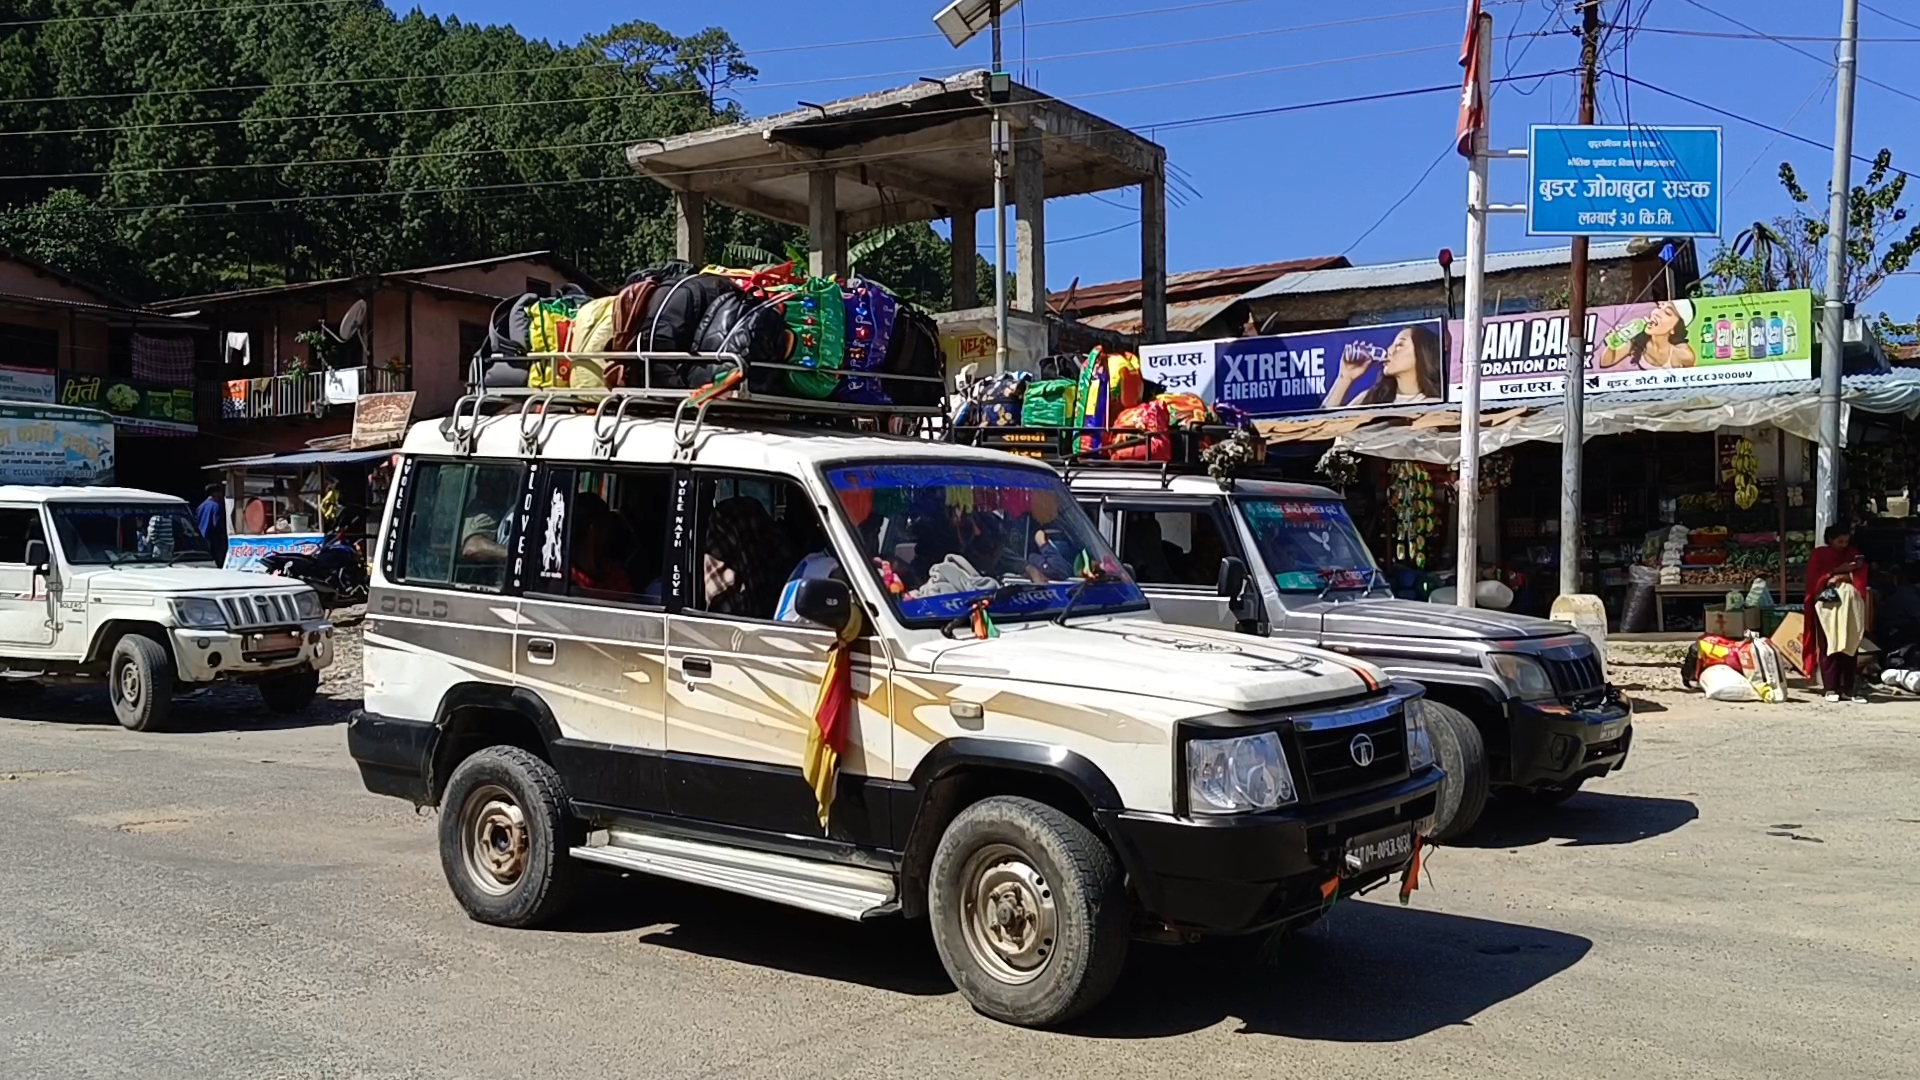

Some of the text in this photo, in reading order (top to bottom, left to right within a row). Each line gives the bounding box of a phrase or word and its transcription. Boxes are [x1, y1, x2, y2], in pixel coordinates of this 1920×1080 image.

[1538, 173, 1711, 203] बुडर जोगबुढा सडक
[1578, 208, 1617, 226] लम्बाई
[1480, 320, 1525, 361] AM
[1148, 352, 1207, 368] एन.एस.
[1223, 347, 1326, 384] XTREME
[1479, 354, 1593, 376] DRATION DRK
[1223, 375, 1327, 401] ENERGY DRINK
[1499, 380, 1556, 395] एन.एस.
[514, 471, 535, 576] LOVER
[671, 564, 681, 596] LOVE
